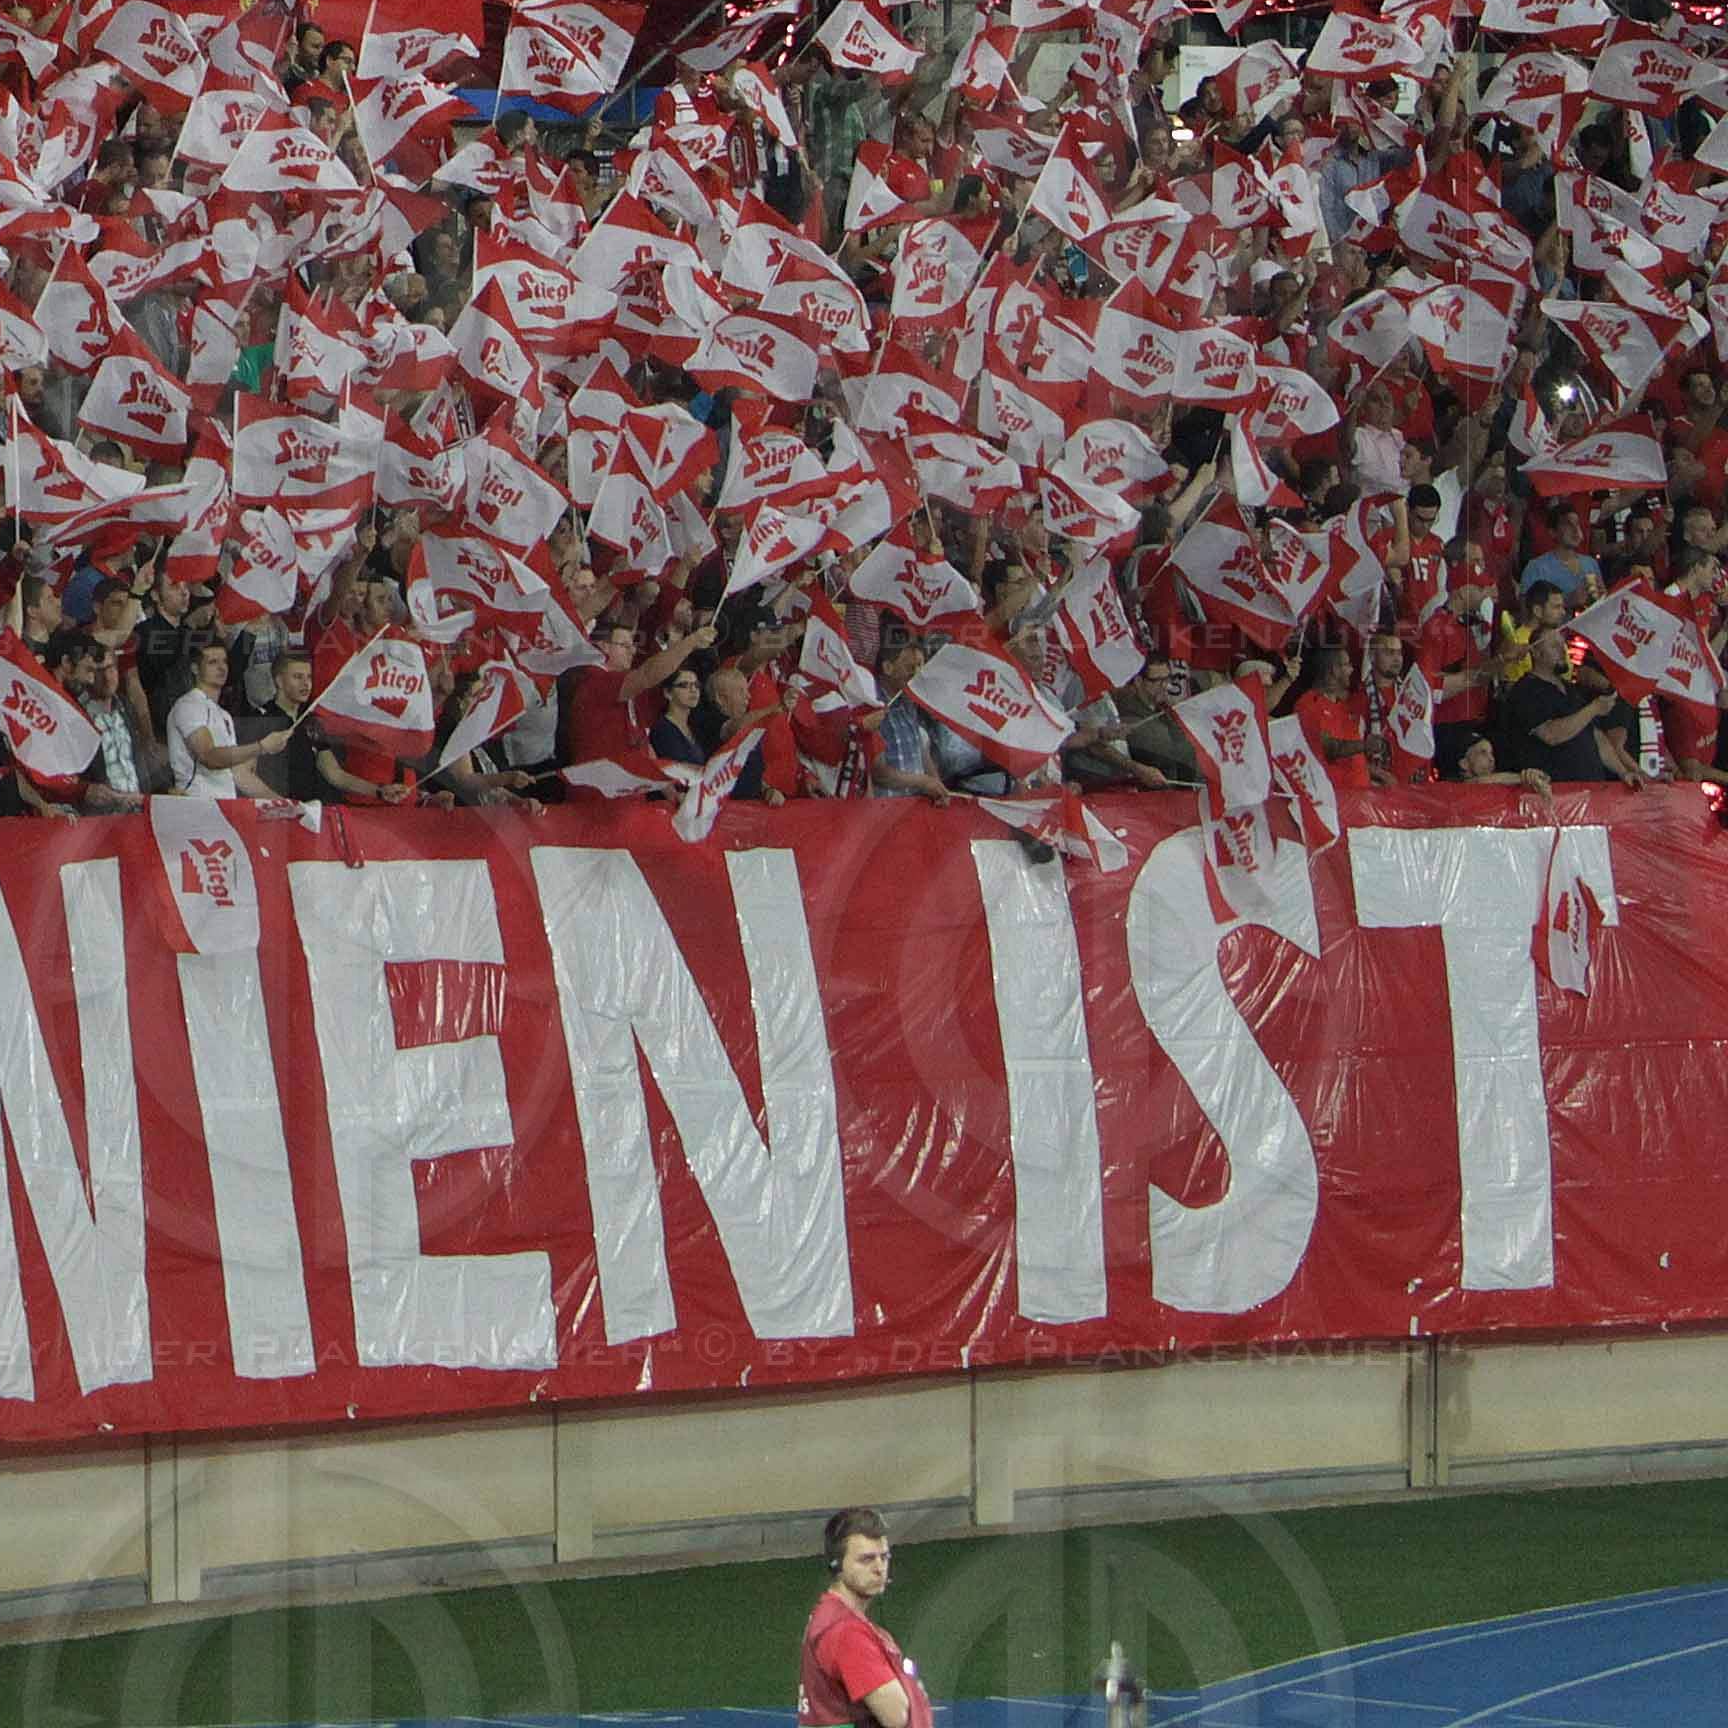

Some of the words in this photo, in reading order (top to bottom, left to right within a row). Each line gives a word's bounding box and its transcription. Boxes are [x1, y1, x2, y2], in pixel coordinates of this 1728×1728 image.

[140, 17, 199, 66] Stiegl
[528, 35, 577, 73] Stiegl
[1633, 48, 1693, 85] Stiegl
[269, 134, 338, 165] Stiegl
[517, 274, 578, 304] Stiegl
[798, 291, 856, 326] Stiegl
[276, 427, 341, 465] Stiegl
[746, 438, 806, 473] Stiegl
[364, 652, 425, 696] Stiegl
[2, 679, 59, 734] Stiegl
[965, 670, 1031, 720] Stiegl
[188, 838, 235, 908] Stiegl
[968, 824, 1621, 1328] IST
